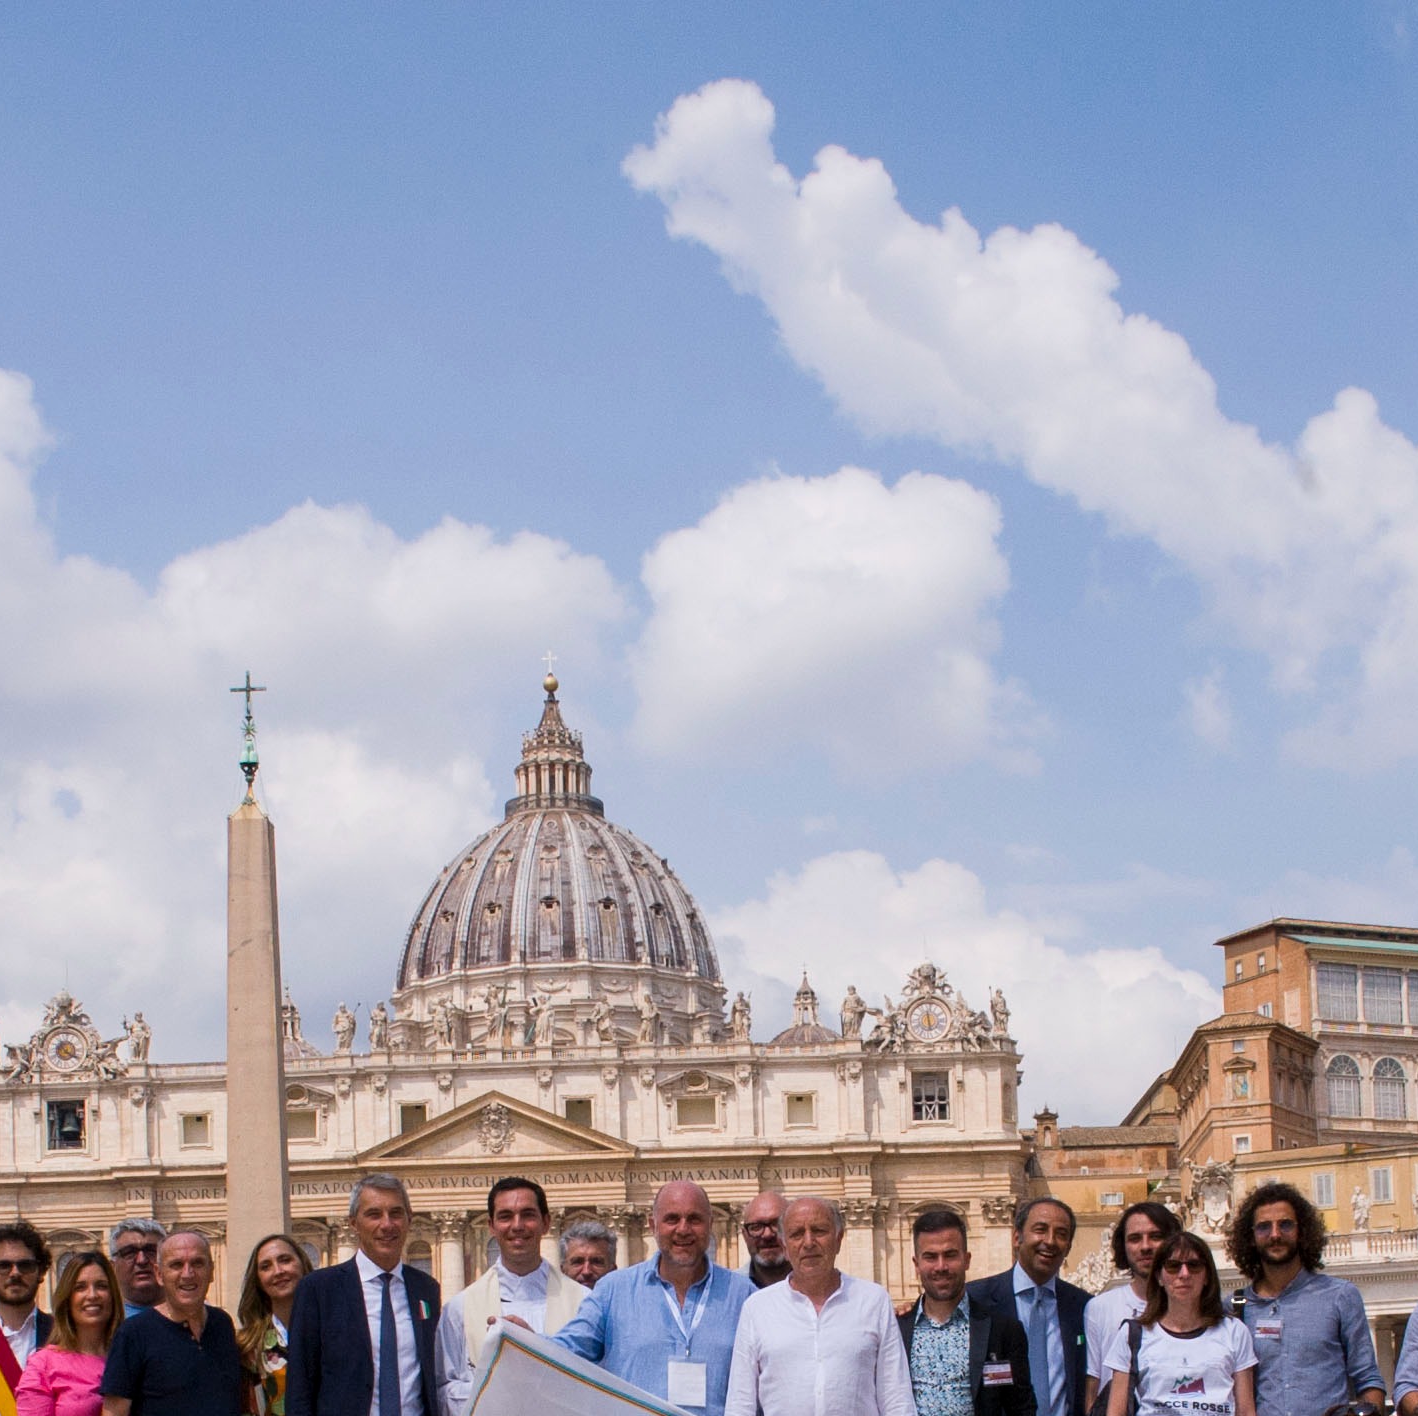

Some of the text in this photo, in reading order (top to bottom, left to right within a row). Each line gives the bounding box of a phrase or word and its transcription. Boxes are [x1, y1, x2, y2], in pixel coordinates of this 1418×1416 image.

[127, 1189, 145, 1201] IN
[291, 1183, 319, 1195] IPIS
[321, 1181, 353, 1194] APO
[544, 1171, 624, 1186] ROMANVS
[1192, 1401, 1232, 1414] ROSSE
